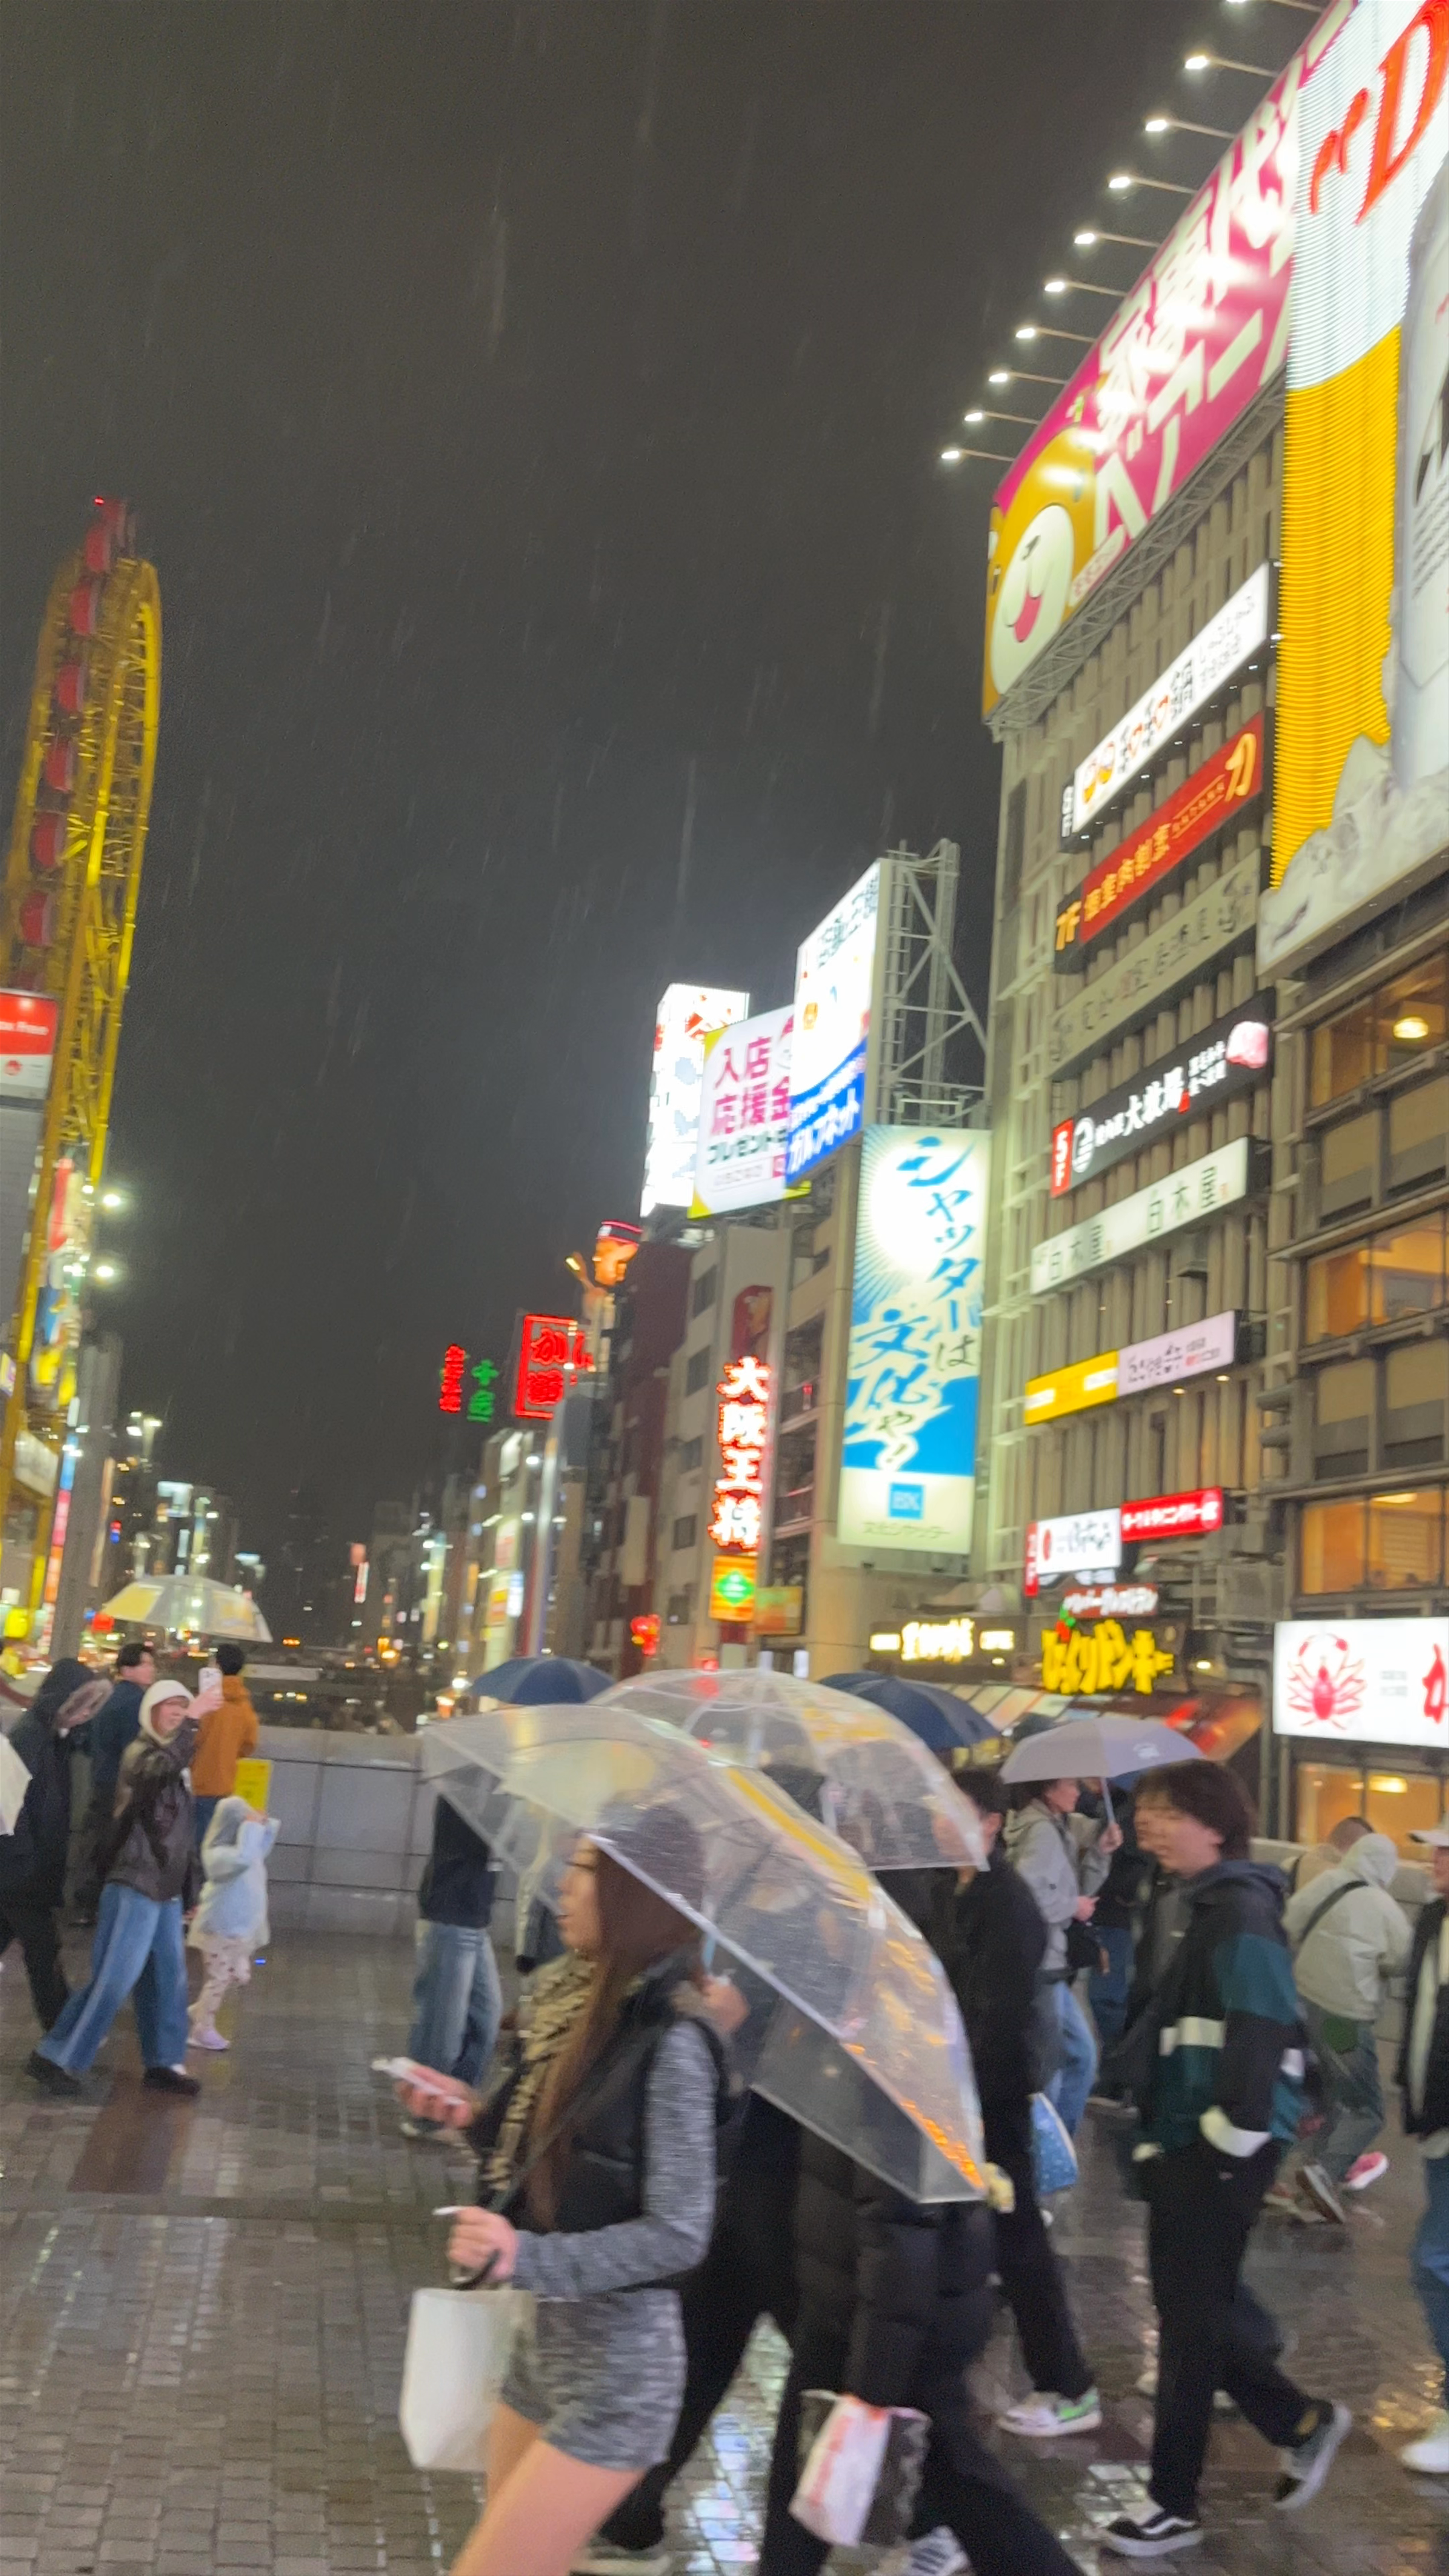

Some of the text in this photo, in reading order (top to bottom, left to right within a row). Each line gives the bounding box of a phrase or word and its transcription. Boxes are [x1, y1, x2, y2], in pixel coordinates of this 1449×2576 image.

[714, 1036, 772, 1090] 入店
[1146, 1165, 1217, 1235] 白木屋
